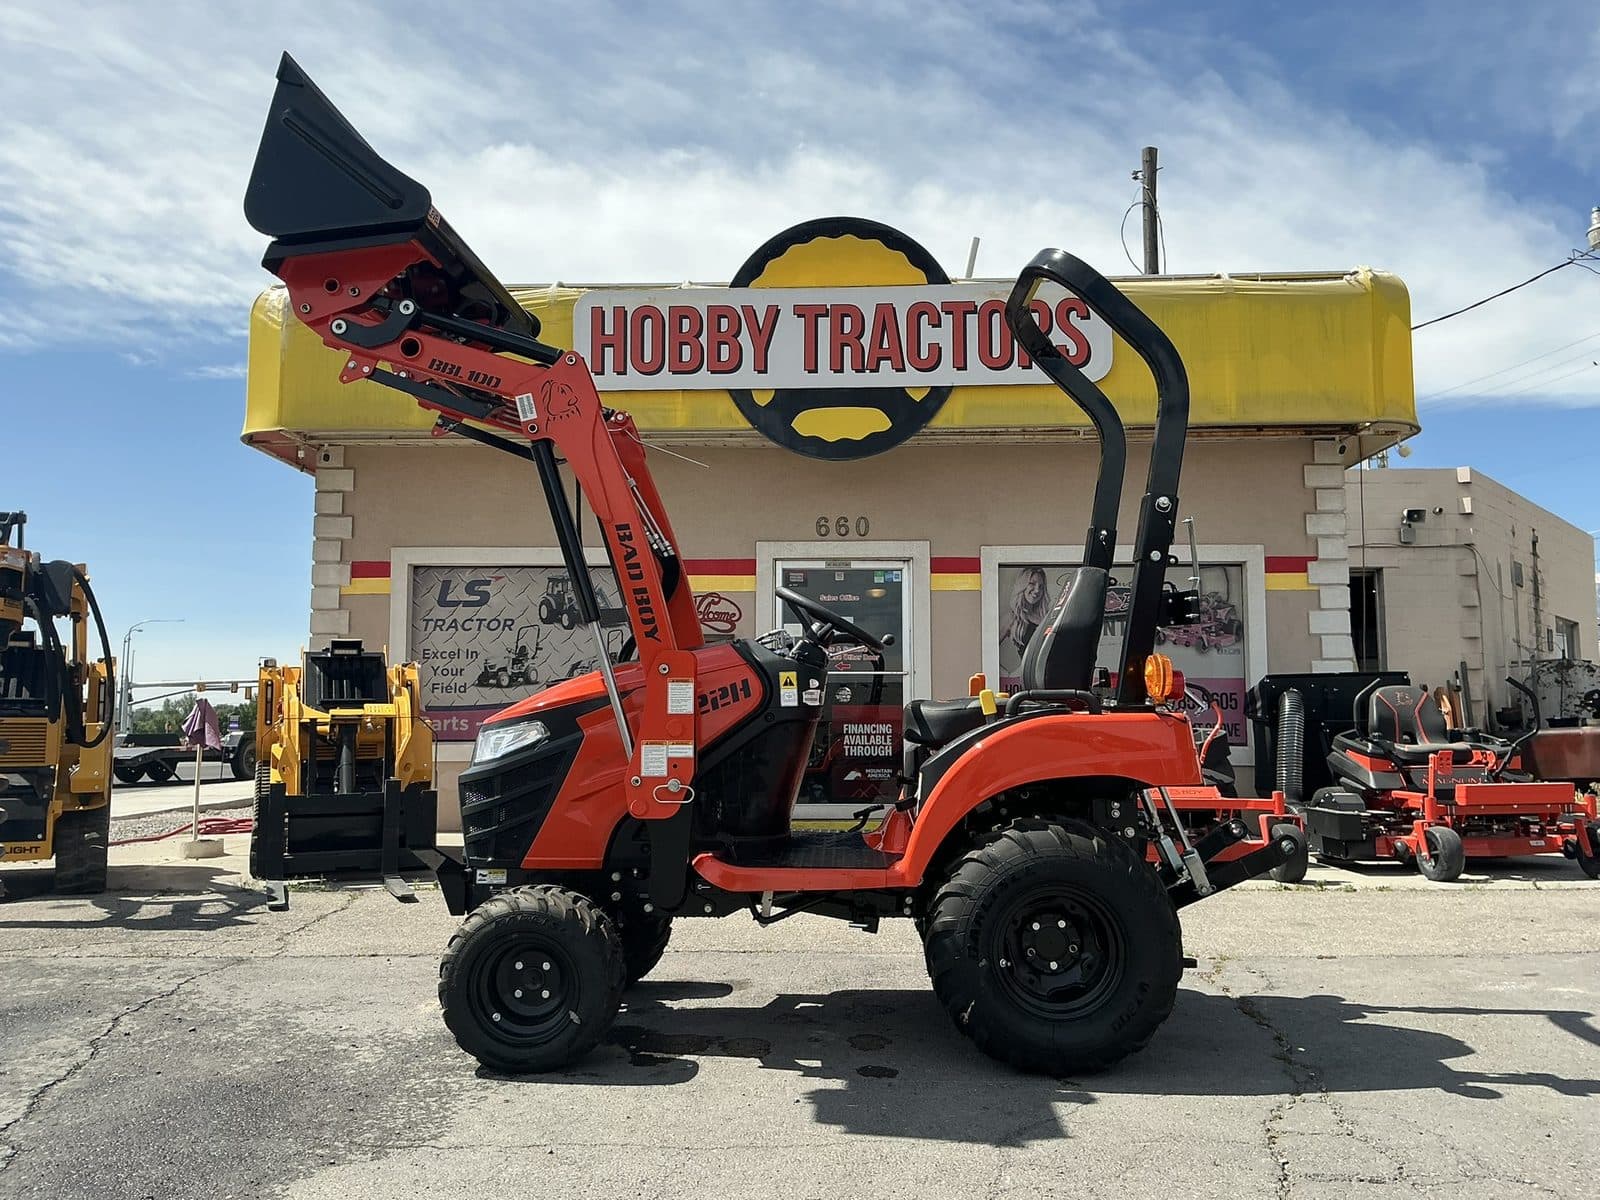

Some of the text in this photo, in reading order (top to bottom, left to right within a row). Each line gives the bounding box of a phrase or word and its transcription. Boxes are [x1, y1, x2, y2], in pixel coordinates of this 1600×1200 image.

[589, 297, 1092, 376] HOBBY TRACTORS
[428, 358, 502, 388] BBL 100
[815, 516, 870, 537] 660
[614, 523, 662, 643] BAD BOY
[436, 579, 493, 608] LS
[819, 593, 860, 601] Sales Office
[422, 618, 515, 632] TRACTOR
[422, 648, 479, 660] Excel In
[430, 665, 465, 677] Your
[431, 682, 467, 694] Field
[423, 716, 469, 731] arts
[843, 723, 892, 734] FINANCING
[843, 734, 892, 745] AVAILABLE
[843, 745, 892, 757] THROUGH
